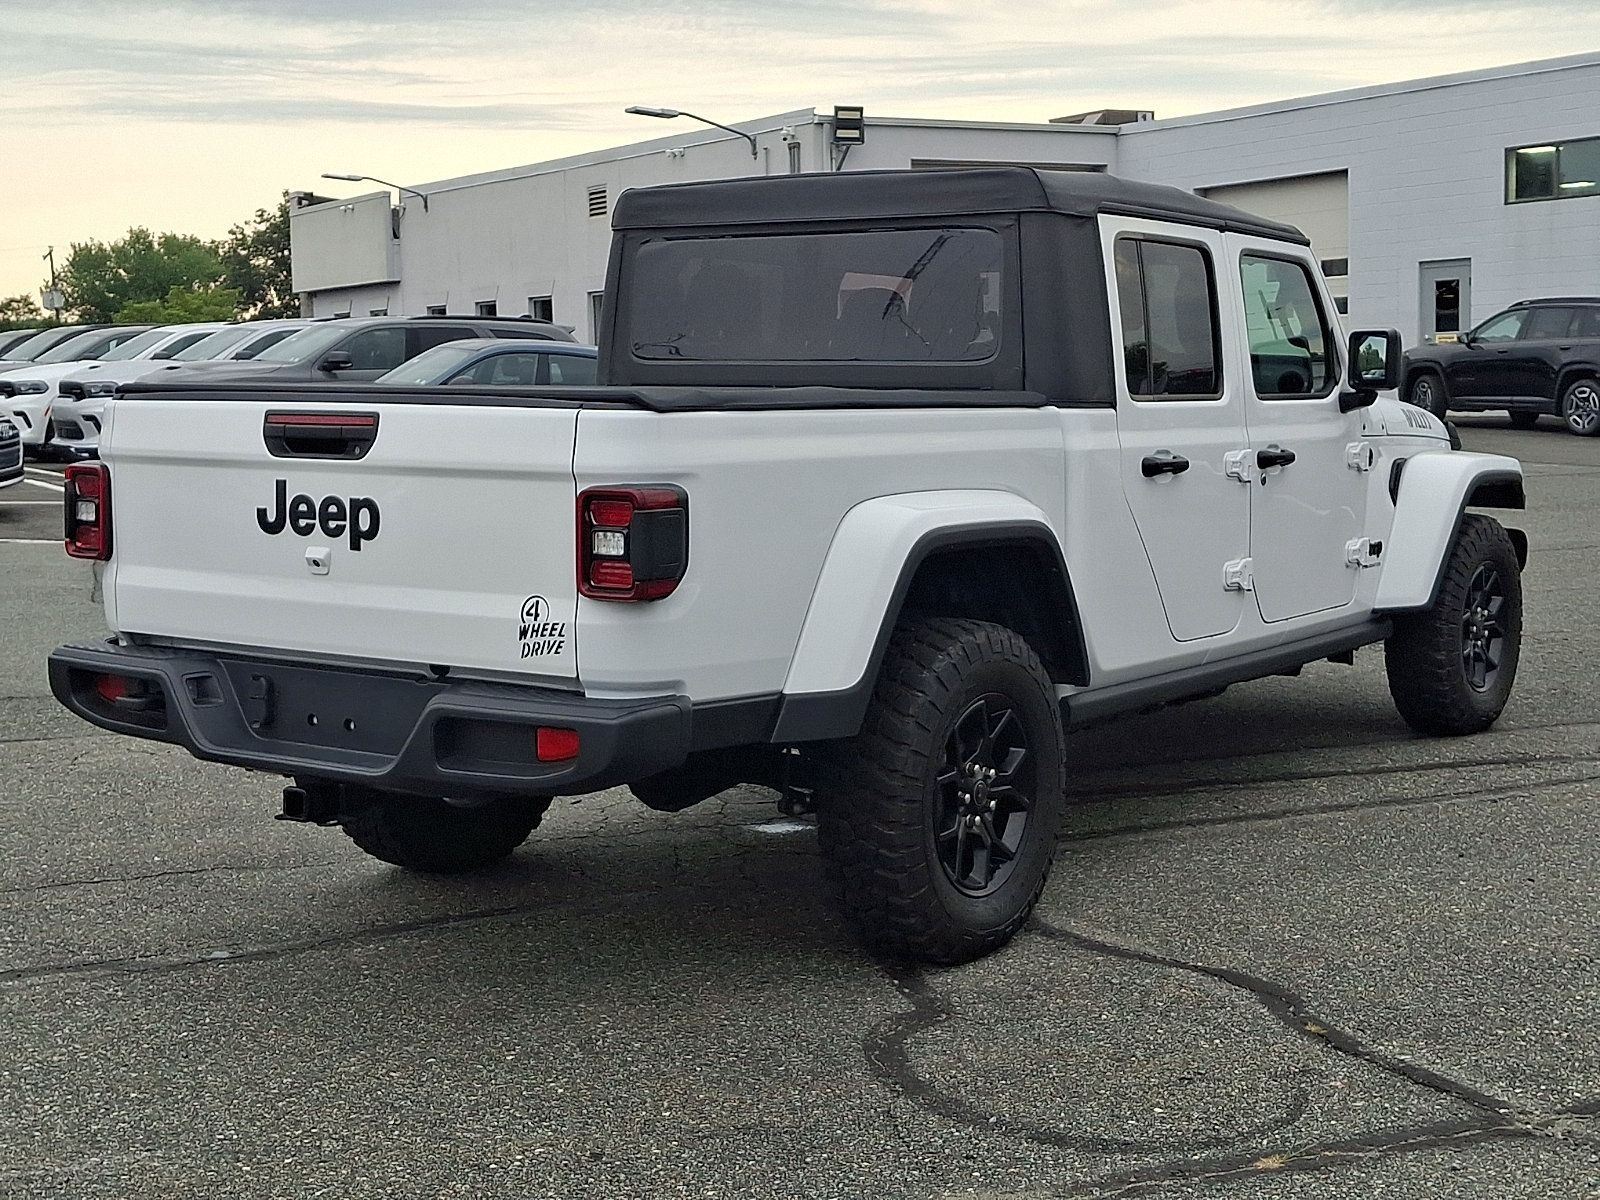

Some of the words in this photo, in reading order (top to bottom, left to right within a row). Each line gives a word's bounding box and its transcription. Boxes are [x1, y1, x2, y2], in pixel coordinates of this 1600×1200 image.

[256, 479, 380, 551] Jeep
[524, 598, 543, 622] 4
[518, 622, 566, 641] WHEEL
[520, 639, 566, 659] DRIVE
